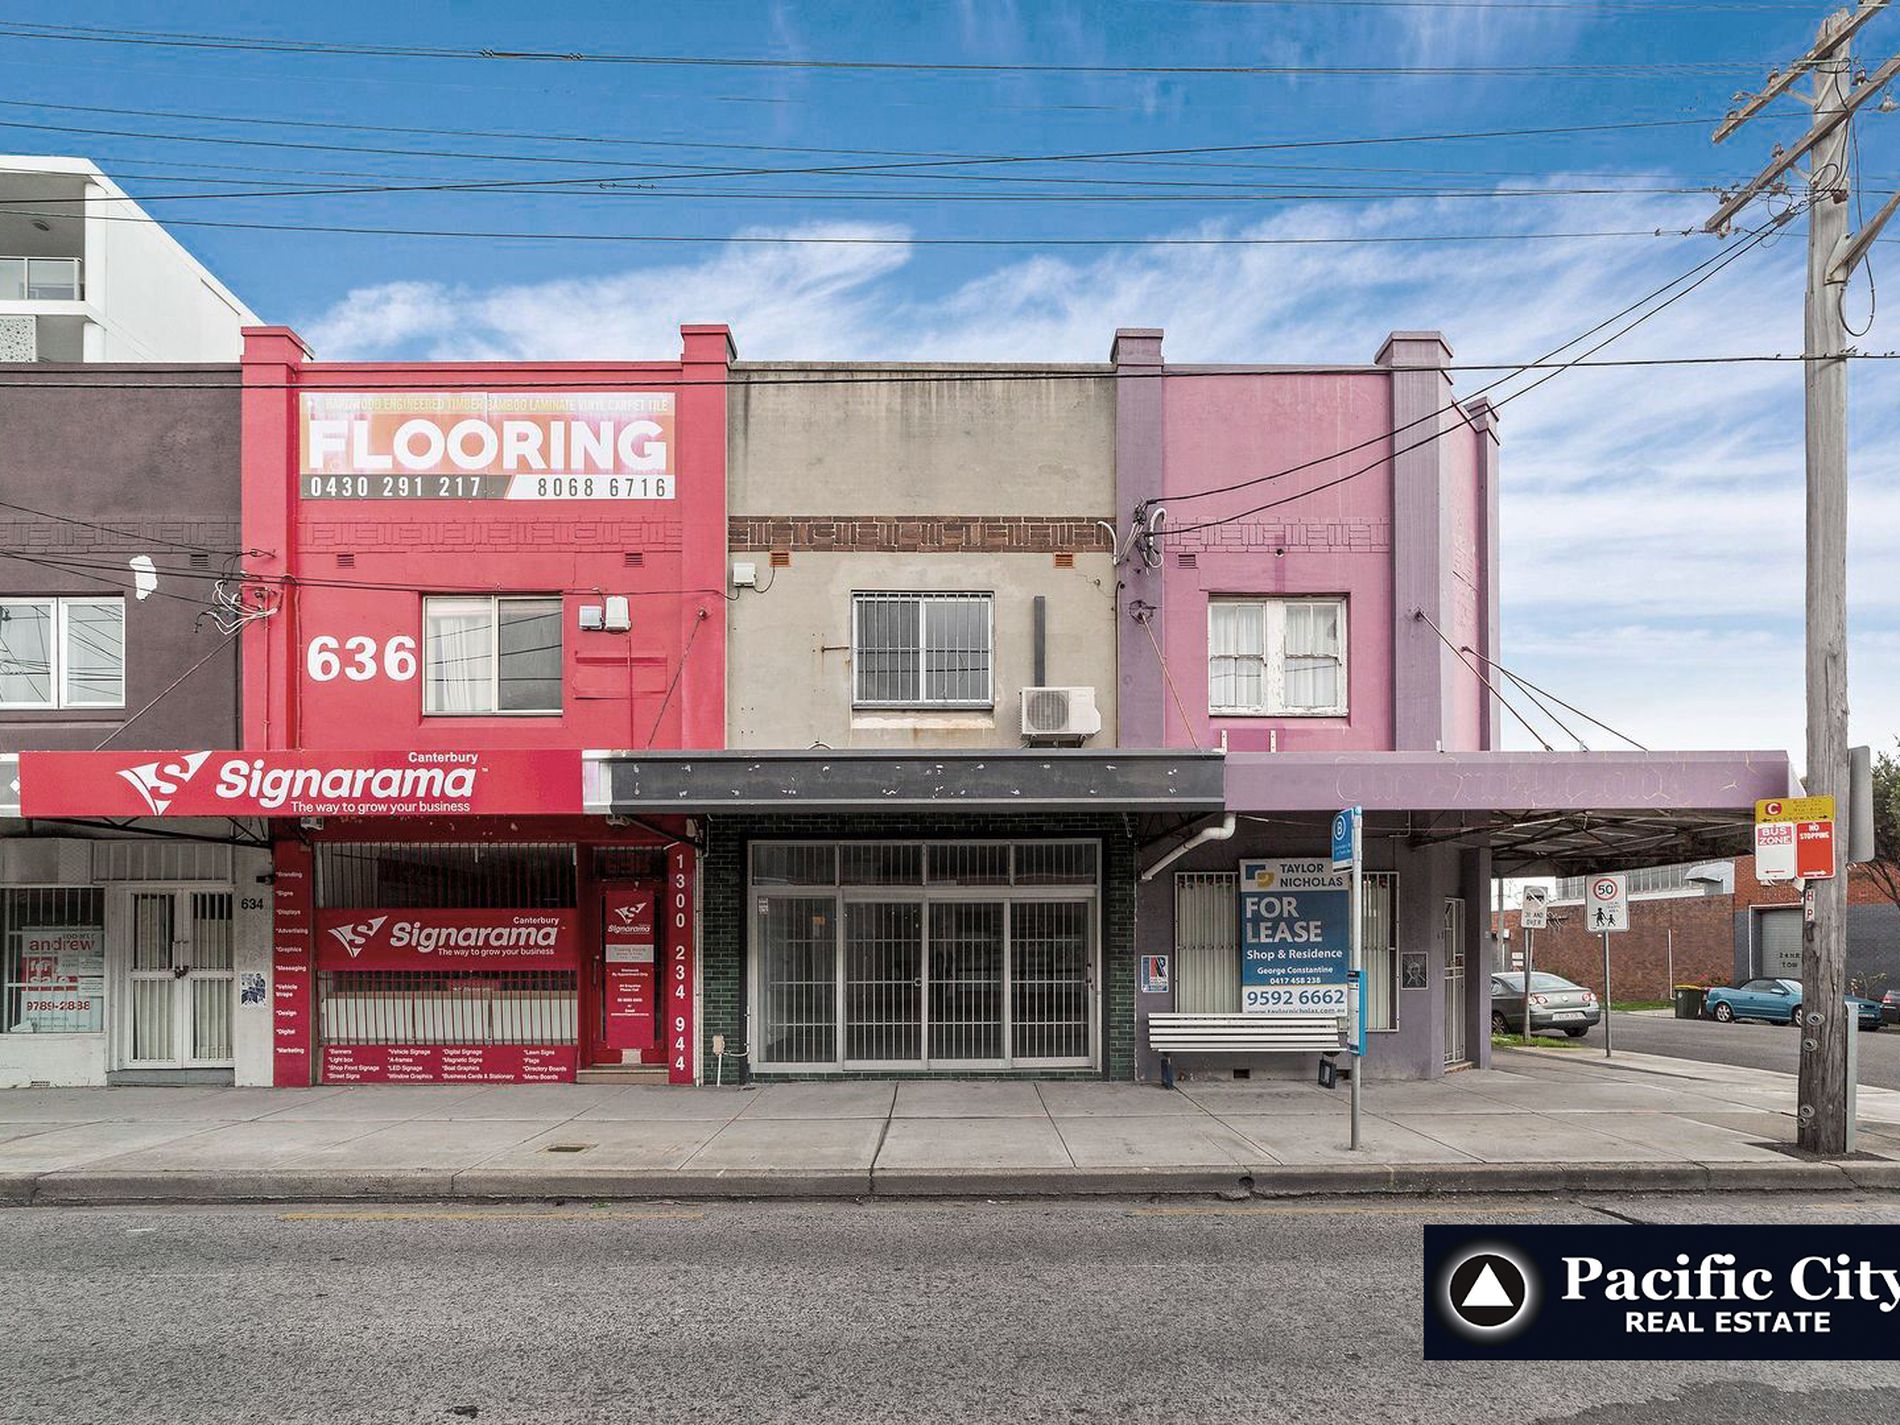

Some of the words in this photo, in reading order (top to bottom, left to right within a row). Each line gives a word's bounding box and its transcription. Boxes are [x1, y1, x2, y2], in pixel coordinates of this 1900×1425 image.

[447, 398, 484, 411] TIMBER
[308, 418, 667, 471] FLOORING
[310, 476, 368, 498] 0430
[383, 476, 422, 498] 291
[439, 476, 481, 498] 217
[537, 477, 593, 498] 8068
[609, 477, 666, 498] 6716
[307, 634, 417, 682] 636
[408, 752, 479, 765] Canterbury
[215, 758, 477, 808] Signarama
[291, 801, 314, 812] The
[316, 803, 340, 815] way
[342, 802, 356, 812] to
[358, 803, 386, 815] grow
[389, 803, 417, 815] your
[419, 801, 470, 812] business
[1767, 802, 1780, 815] C
[1762, 826, 1788, 836] BUS
[1808, 823, 1820, 832] NO
[1759, 835, 1791, 845] ZONE
[1800, 831, 1830, 840] STOPPING
[1280, 863, 1324, 874] TAYLOR
[1280, 877, 1343, 888] NICHOLAS
[675, 854, 686, 928] 1300
[1598, 884, 1613, 895] 50
[241, 898, 264, 910] 634
[1246, 896, 1300, 918] FOR
[513, 916, 560, 926] Canterbury
[608, 924, 651, 934] Signarama
[1246, 921, 1323, 943] LEASE
[390, 921, 558, 953] Signarama
[29, 937, 95, 951] andrew
[438, 948, 452, 956] The
[453, 949, 470, 957] way
[481, 949, 500, 957] grow
[501, 949, 519, 957] your
[520, 948, 555, 956] business
[1247, 950, 1275, 961] Shop
[1278, 949, 1286, 959] &
[1289, 949, 1343, 959] Residence
[675, 945, 686, 1000] 234
[1257, 966, 1286, 975] George
[1287, 966, 1334, 974] Constantine
[1247, 990, 1293, 1006] 9592
[1299, 989, 1345, 1005] 6662
[675, 1016, 686, 1071] 944
